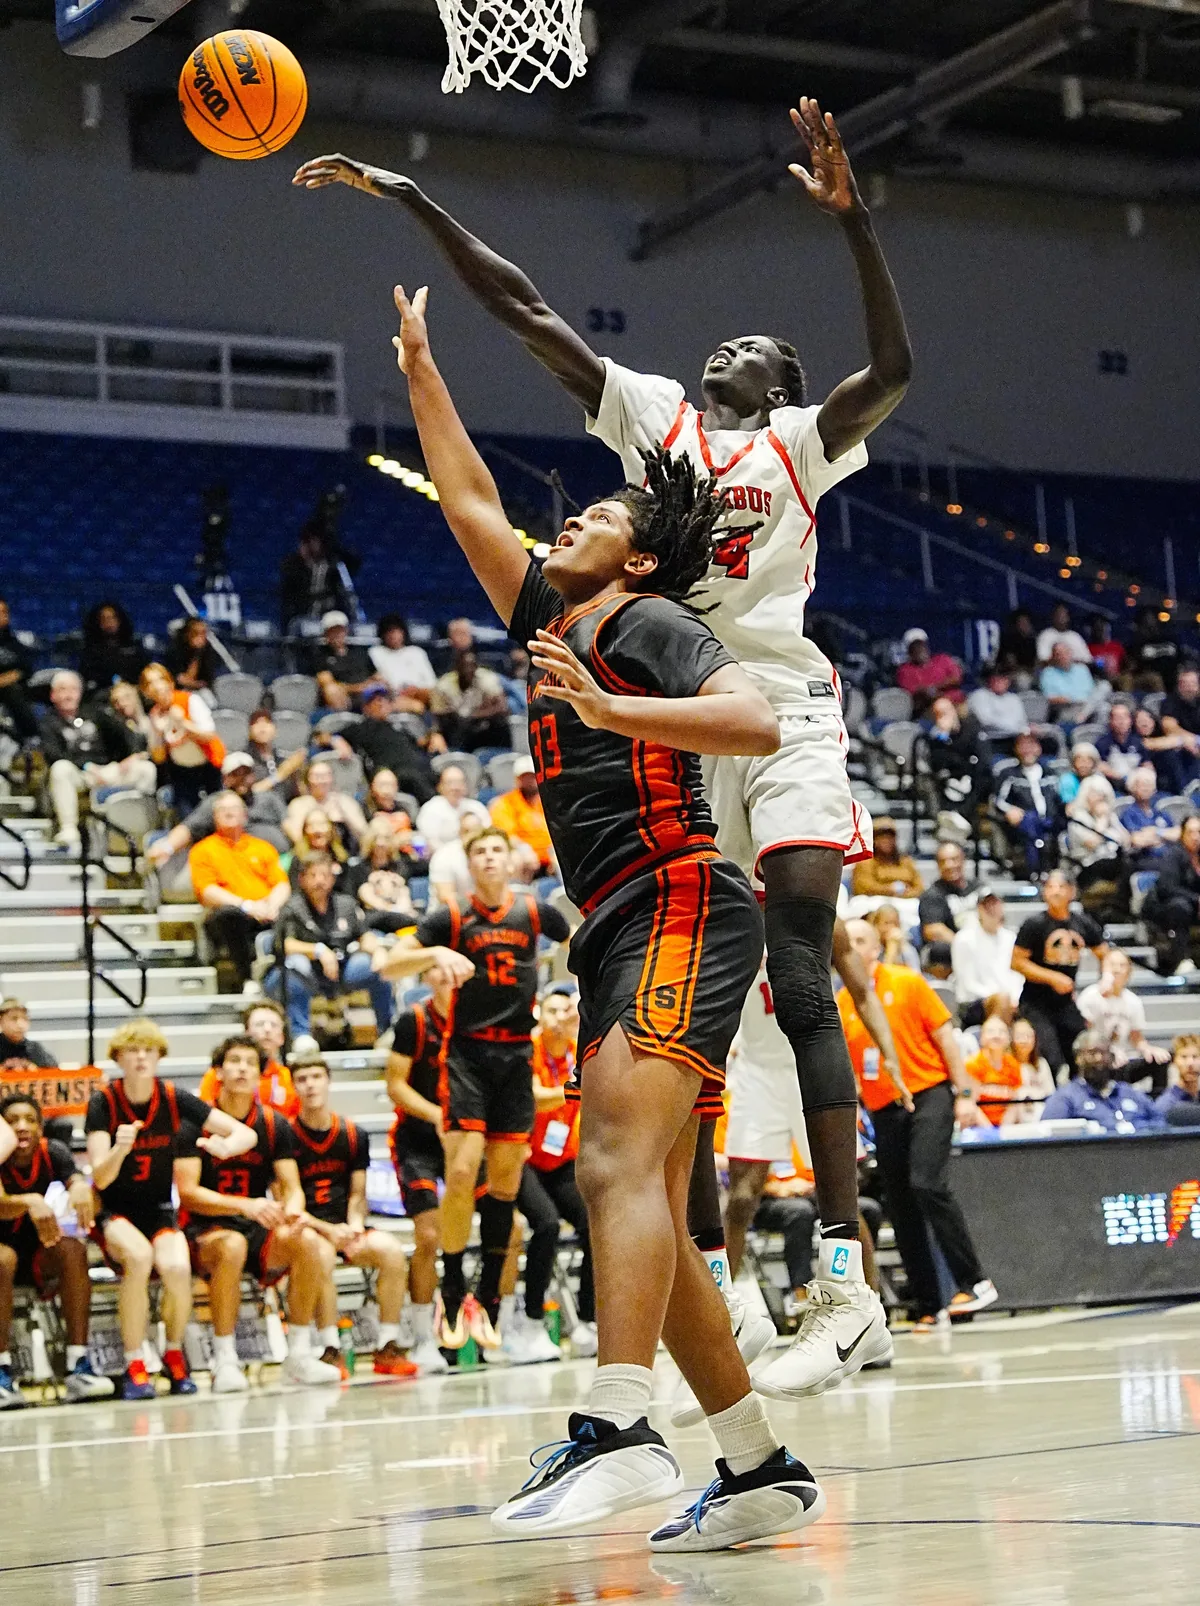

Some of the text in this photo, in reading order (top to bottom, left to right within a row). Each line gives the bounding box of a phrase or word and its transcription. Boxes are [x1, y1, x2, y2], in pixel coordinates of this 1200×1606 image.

[485, 951, 518, 987] 12
[654, 985, 677, 1010] S
[132, 1155, 152, 1182] 3
[217, 1168, 251, 1198] 23
[314, 1178, 332, 1205] 2
